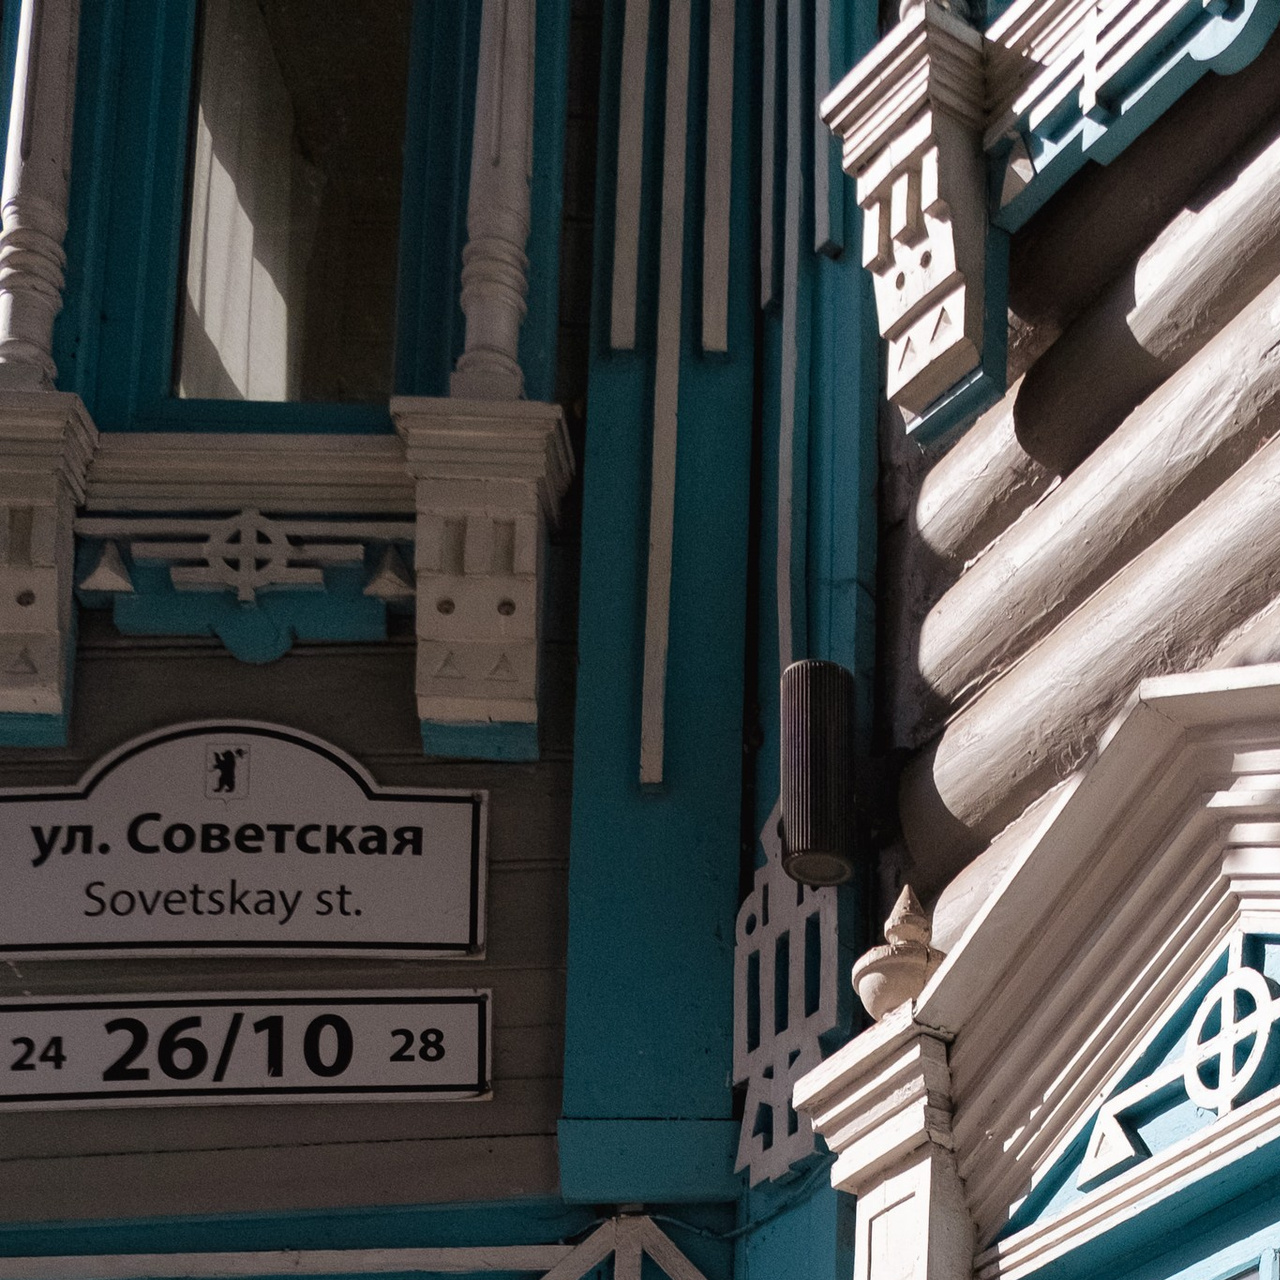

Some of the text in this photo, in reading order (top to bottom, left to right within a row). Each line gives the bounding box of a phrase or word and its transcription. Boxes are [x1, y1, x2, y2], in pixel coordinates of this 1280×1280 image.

[31, 812, 424, 868] ул. Советская
[84, 879, 362, 926] Sovetskay st.
[10, 1012, 446, 1082] 24 26/10 28
